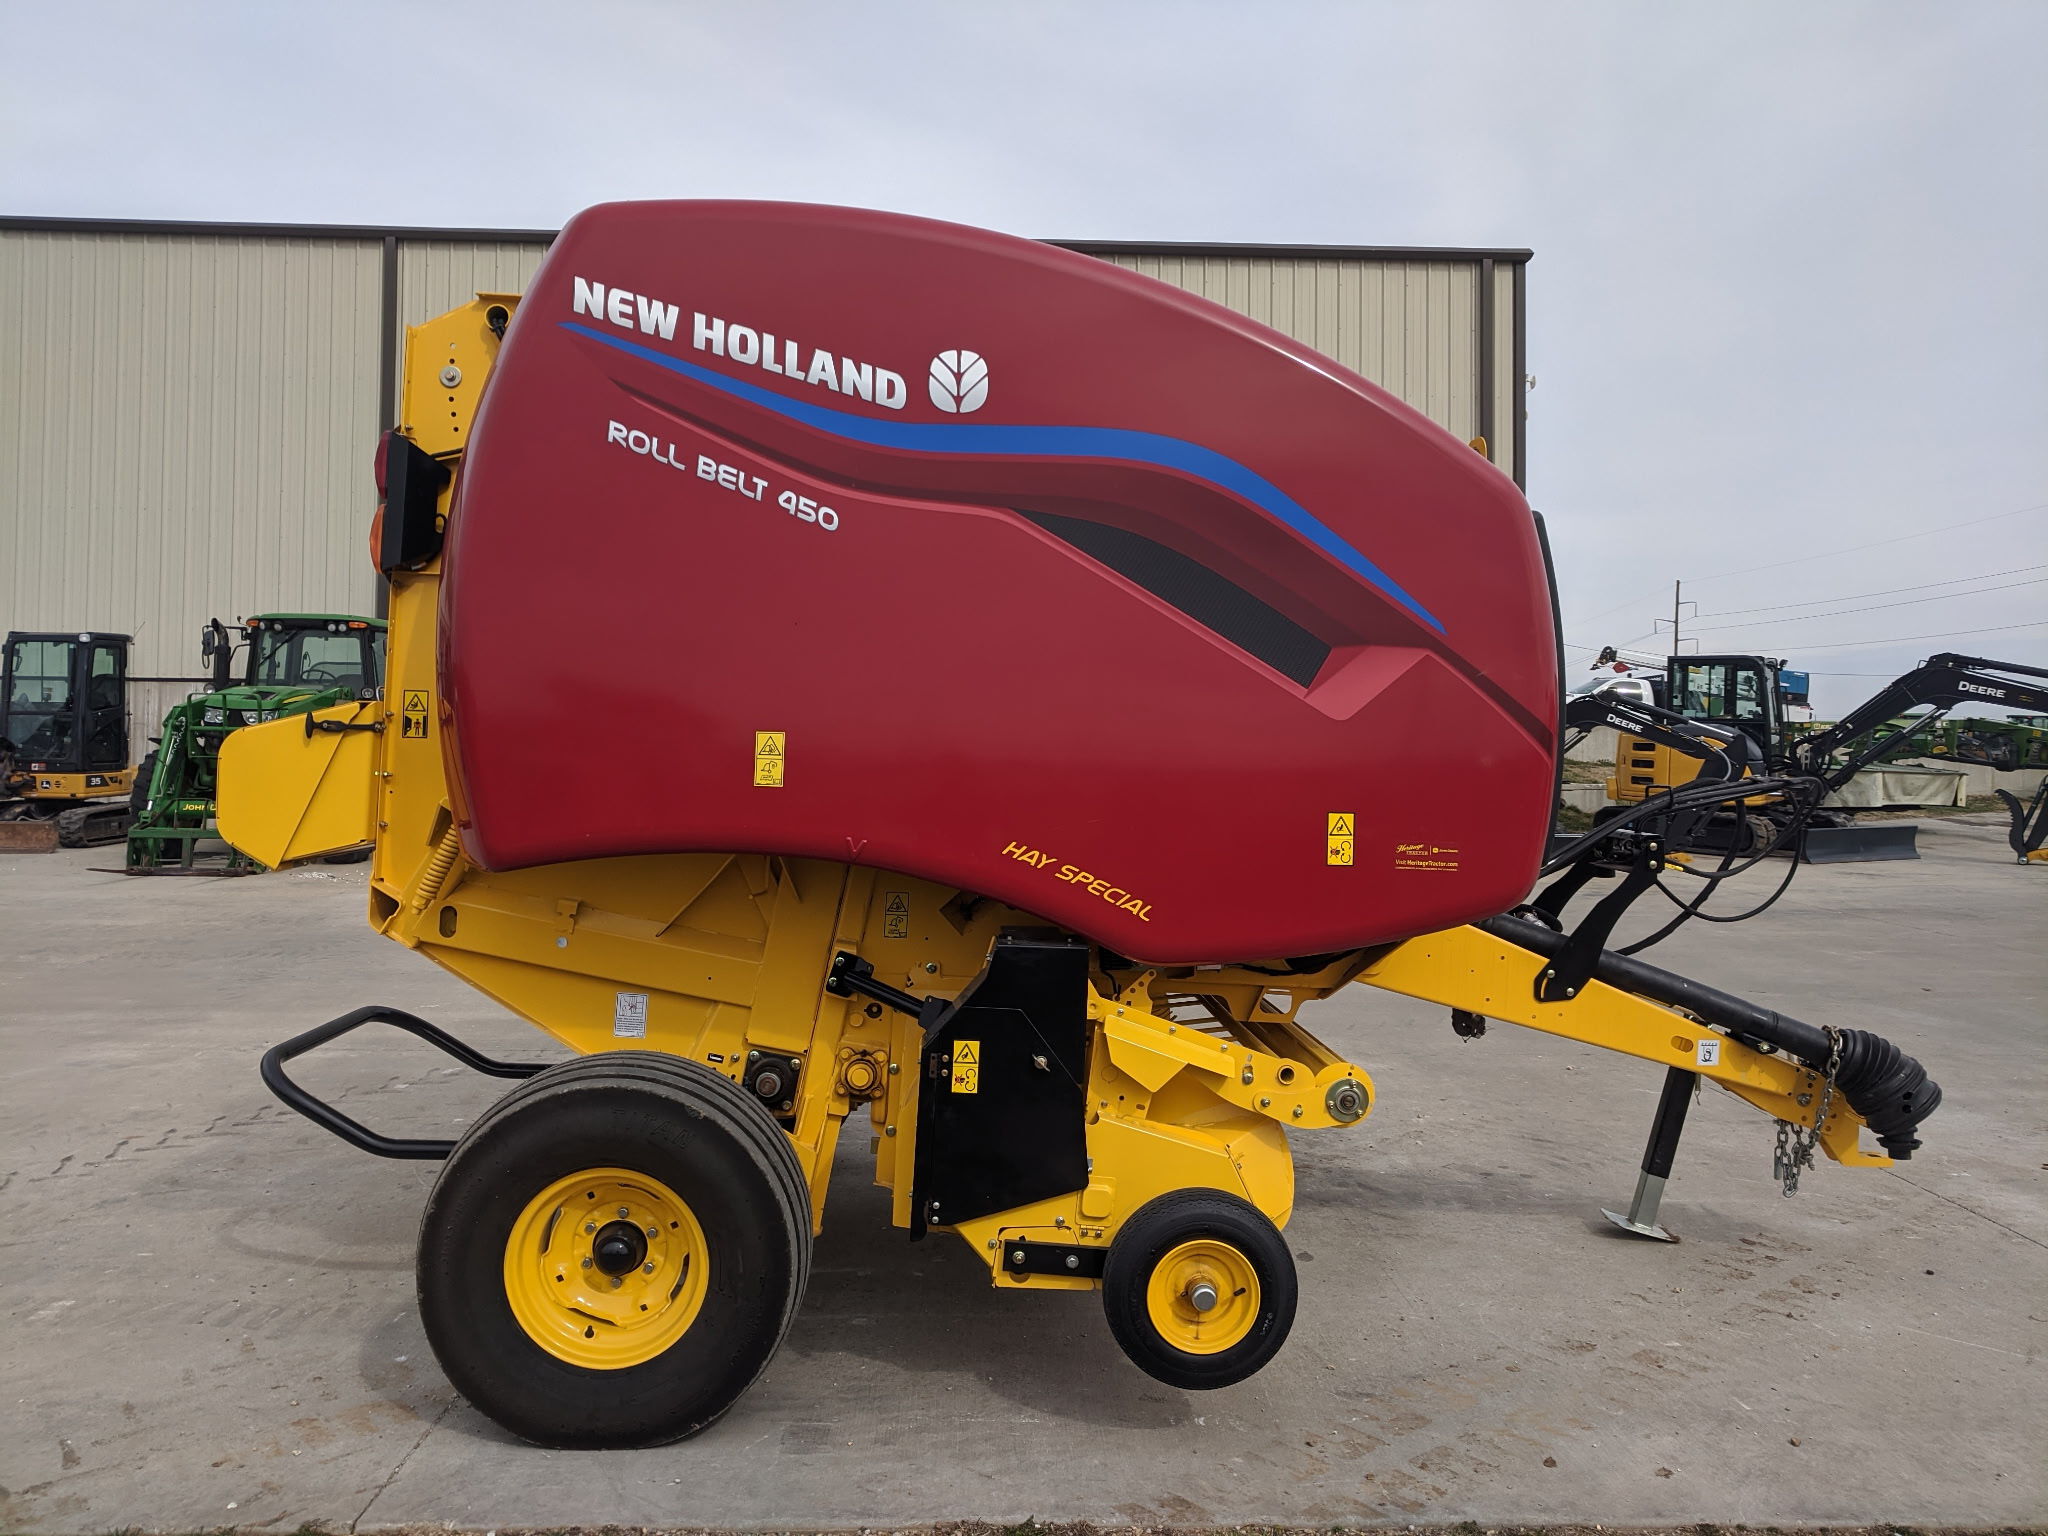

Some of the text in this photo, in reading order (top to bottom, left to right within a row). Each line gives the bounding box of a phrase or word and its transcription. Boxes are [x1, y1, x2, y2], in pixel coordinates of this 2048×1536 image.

[573, 275, 907, 410] NEW HOLLAND
[607, 420, 839, 531] ROLL BELT 450
[1957, 680, 2006, 698] DEERE
[1606, 713, 1644, 733] DEERE
[90, 777, 101, 785] 35
[1001, 841, 1153, 922] HAY SPECIAL
